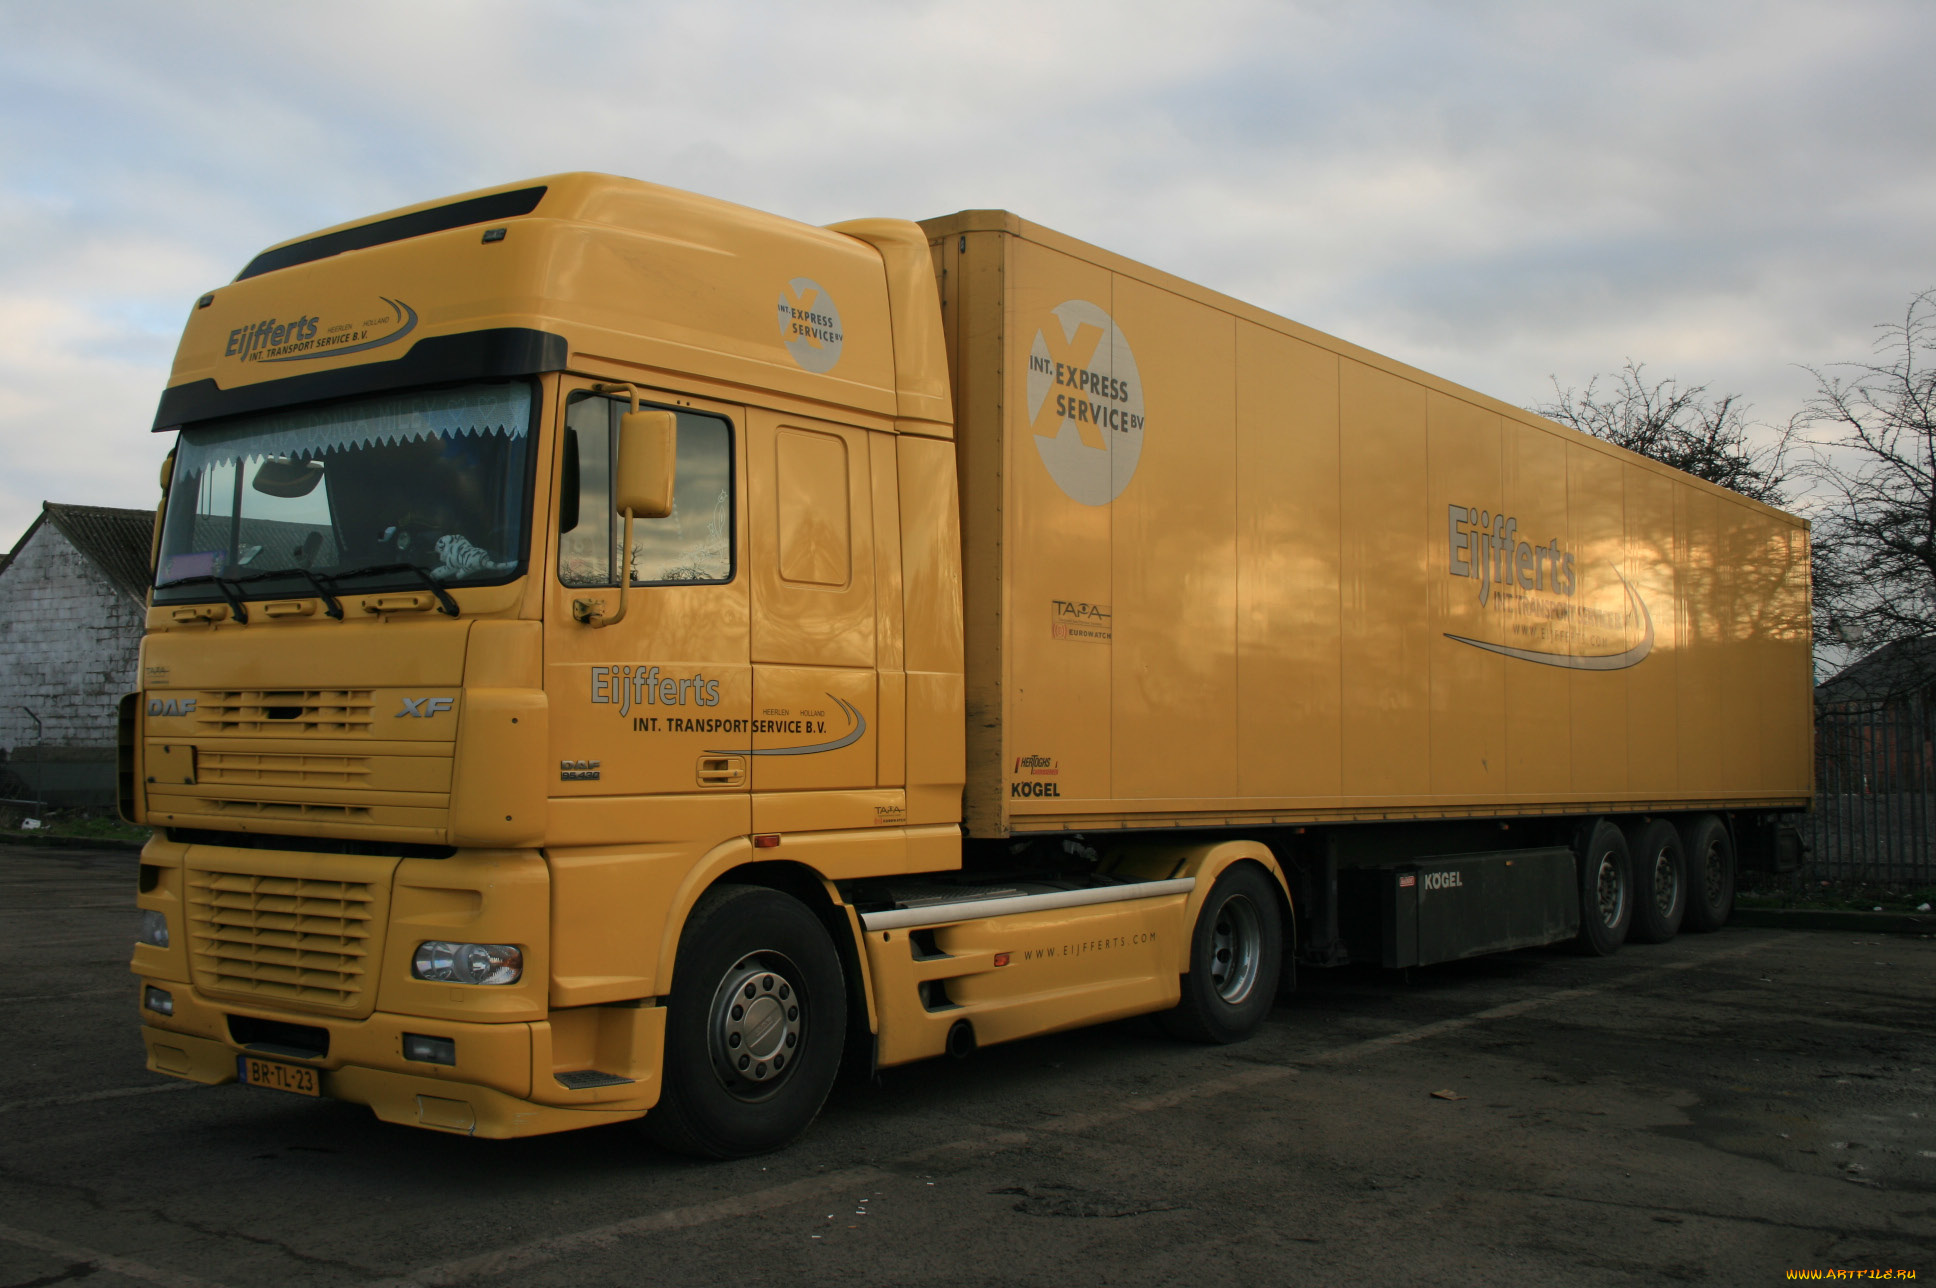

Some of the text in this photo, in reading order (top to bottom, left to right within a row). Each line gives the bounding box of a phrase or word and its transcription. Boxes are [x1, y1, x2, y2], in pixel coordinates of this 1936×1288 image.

[328, 317, 389, 333] HEERLEN HOLLAND
[778, 304, 833, 328] INT. EXPRESS
[225, 316, 319, 362] Eijfferts
[793, 323, 834, 342] SERVICE
[249, 351, 264, 362] INT.
[267, 341, 314, 358] TRANSPORT
[316, 334, 349, 348] SERVICE
[1030, 355, 1129, 403] INT. EXPRESS
[1056, 394, 1144, 433] SERVICE BV
[1448, 503, 1576, 608] Eijfferts
[1516, 595, 1577, 622] TRANSPORT
[1069, 629, 1112, 639] EUROWATCH
[591, 665, 720, 718] Eijfferts
[147, 699, 197, 717] DAF
[394, 697, 454, 718] XF
[763, 708, 789, 716] HEERLEN
[633, 717, 661, 732] INT.
[667, 718, 749, 733] TRANSPORT
[752, 719, 801, 734] SERVICE
[560, 759, 600, 770] DAF
[1011, 781, 1060, 798] KÖGEL
[1424, 871, 1462, 890] KÖGEL
[1024, 932, 1157, 960] WWW.EIJFFERTS.COM
